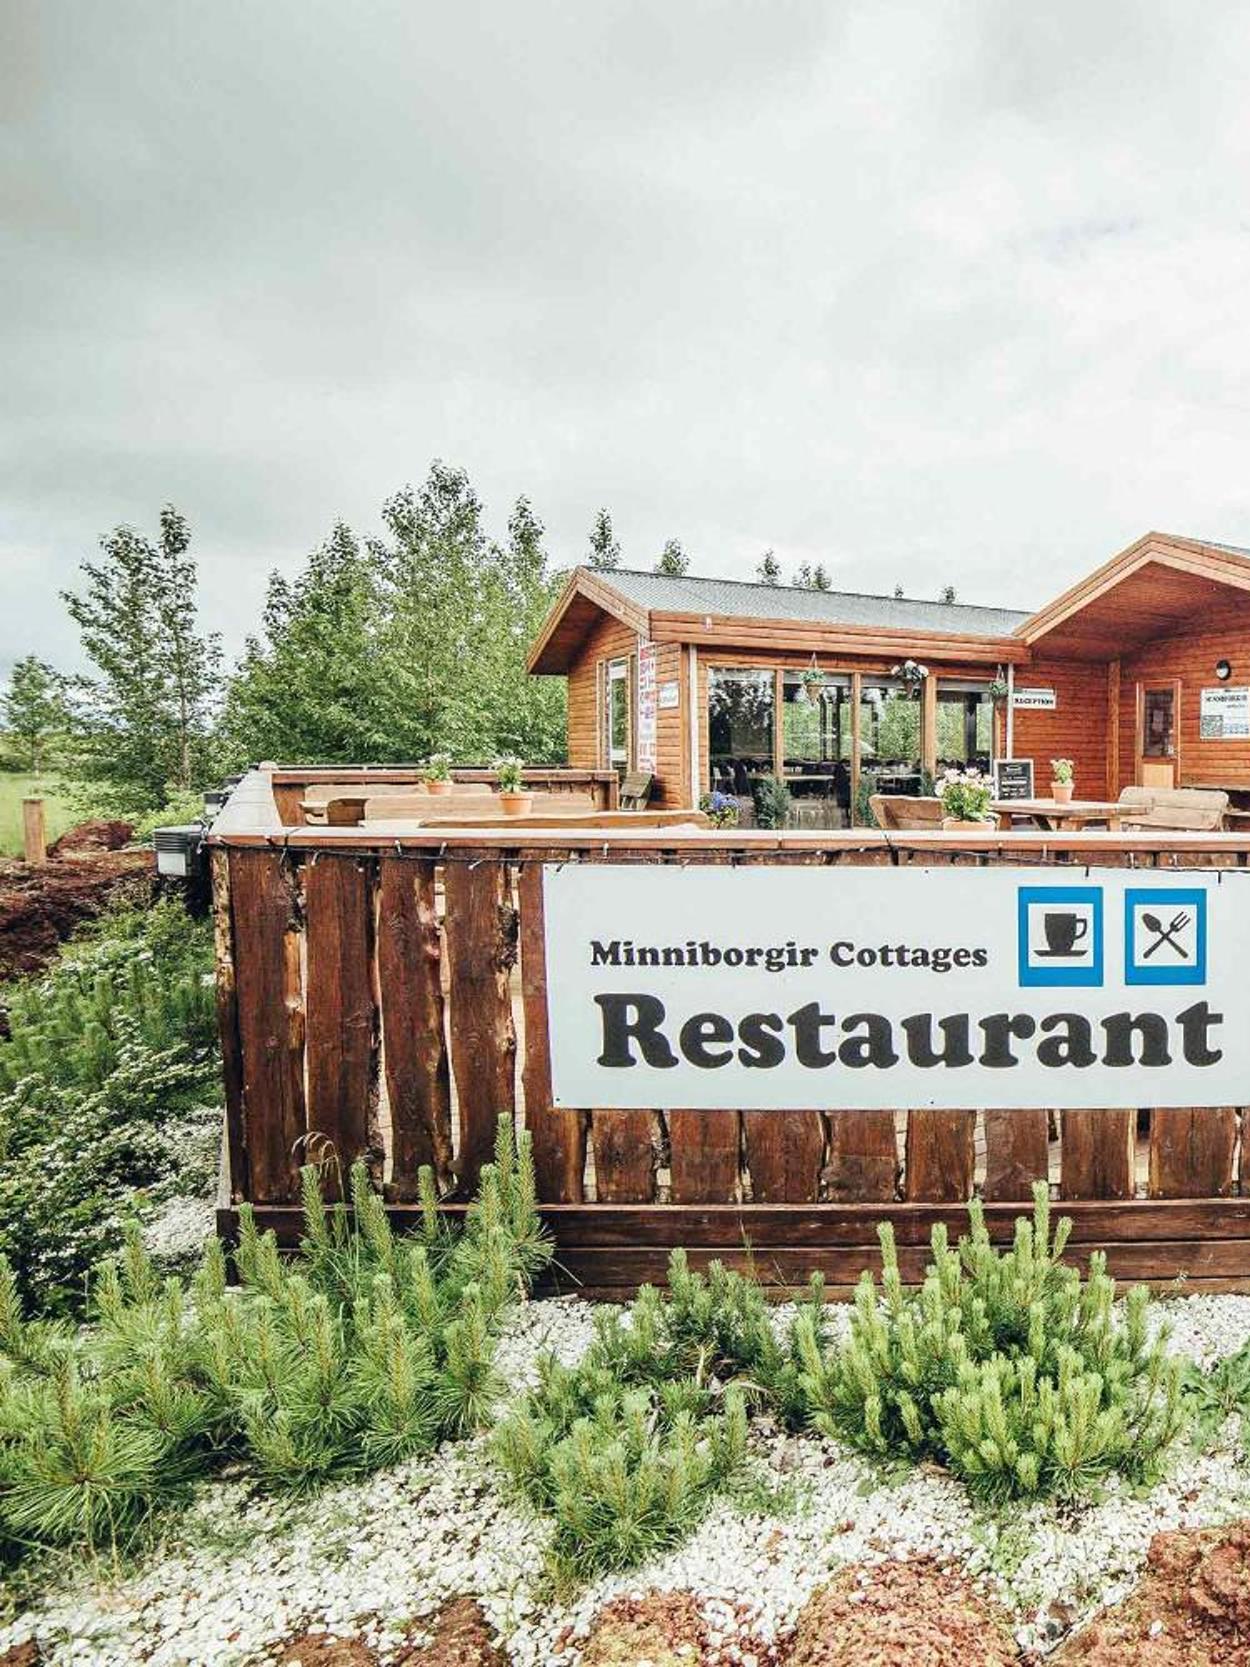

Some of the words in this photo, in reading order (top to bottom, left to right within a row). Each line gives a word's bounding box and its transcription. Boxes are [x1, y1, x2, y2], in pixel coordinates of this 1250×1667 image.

[590, 941, 819, 972] Minniborgir
[830, 942, 988, 972] Cottages
[594, 993, 1223, 1068] Restaurant
